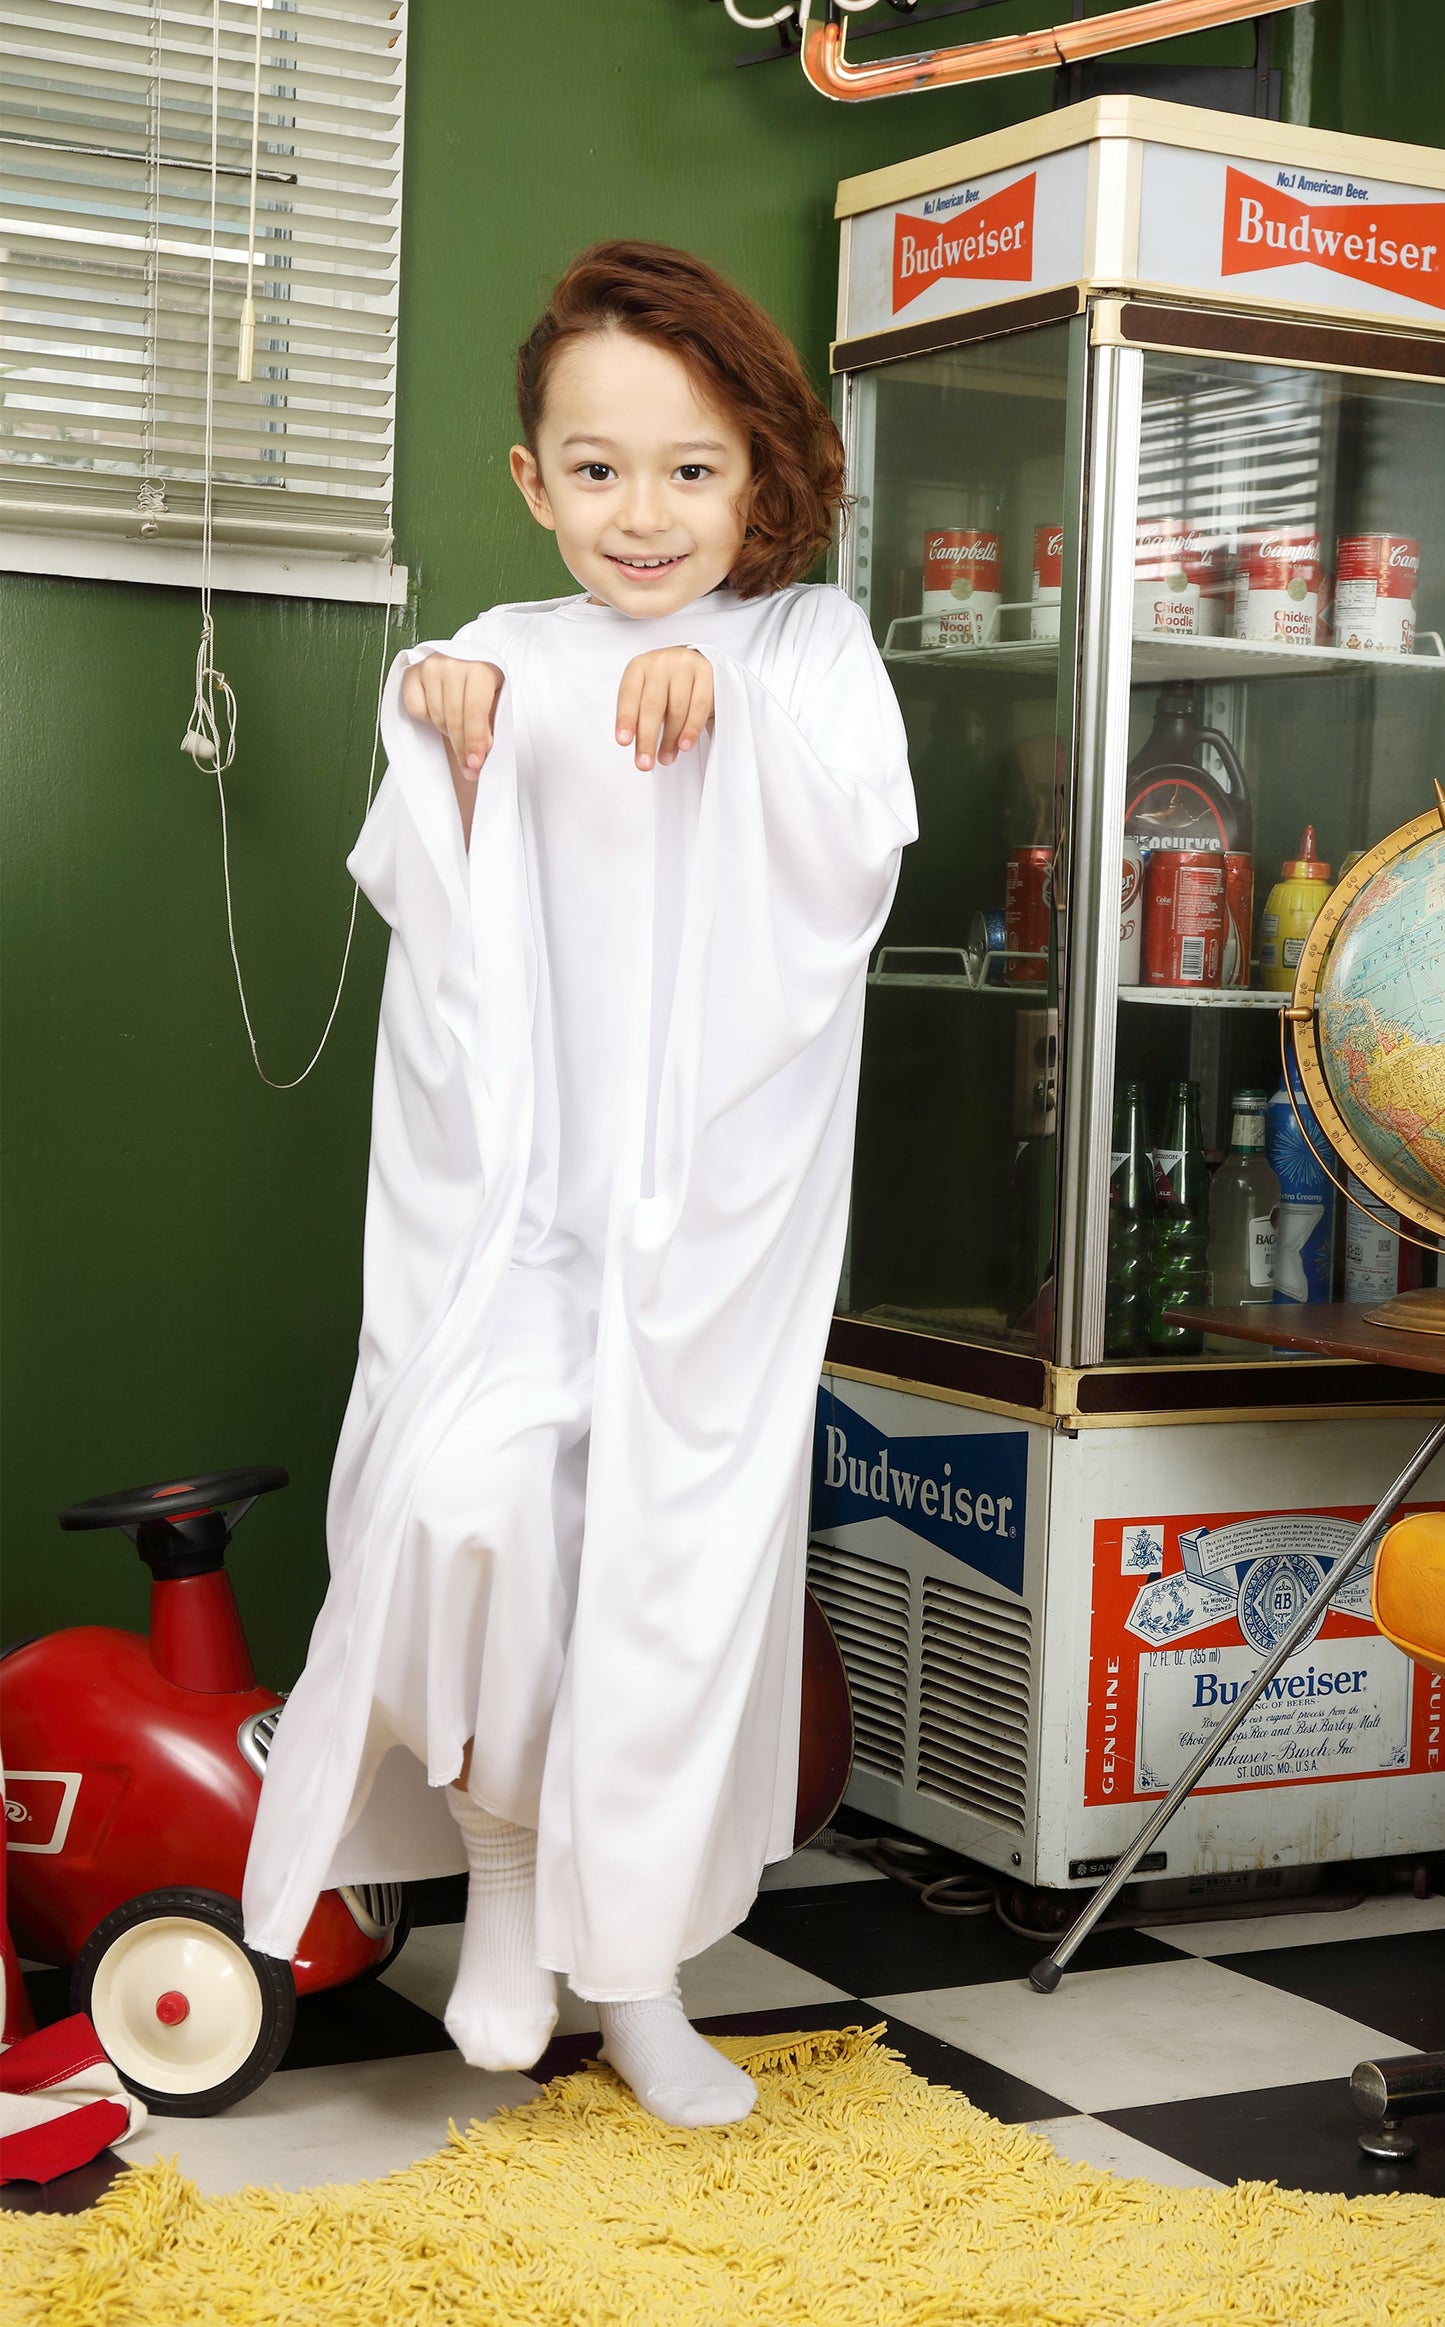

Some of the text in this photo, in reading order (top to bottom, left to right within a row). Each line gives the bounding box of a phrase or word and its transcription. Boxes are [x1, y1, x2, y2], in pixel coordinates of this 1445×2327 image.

[1276, 172, 1369, 200] No.1 American Beer.
[935, 194, 964, 212] American
[965, 189, 980, 203] Beer.
[1237, 197, 1437, 272] Budweiser
[900, 219, 1025, 279] Budweiser
[940, 609, 983, 621] Chickn
[1154, 601, 1195, 615] Chicken
[1274, 610, 1313, 623] Chicken
[940, 621, 981, 632] Noode
[1155, 613, 1193, 627] Noodle
[1275, 621, 1312, 635] Noodle
[1296, 1192, 1323, 1202] Creamy
[824, 1425, 1013, 1538] Budweiser
[1203, 1603, 1232, 1613] RENOWNED
[1210, 1596, 1230, 1605] WORLD
[1149, 1651, 1158, 1667] 12
[1192, 1666, 1368, 1708] Buweiser
[1251, 1699, 1316, 1711] ING OF BEERS
[1266, 1709, 1297, 1724] original
[1297, 1710, 1325, 1721] process
[1328, 1706, 1345, 1718] from
[1349, 1705, 1361, 1715] the
[1427, 1671, 1442, 1767] NUINE
[1102, 1655, 1120, 1795] GENUINE
[1248, 1725, 1268, 1740] Rice
[1271, 1725, 1291, 1737] and
[1294, 1719, 1318, 1735] Best
[1318, 1717, 1354, 1735] Barley
[1356, 1713, 1381, 1731] Malt
[1237, 1767, 1249, 1778] ST.
[1250, 1763, 1276, 1778] LOUIS,
[1295, 1760, 1318, 1772] U.S.A.
